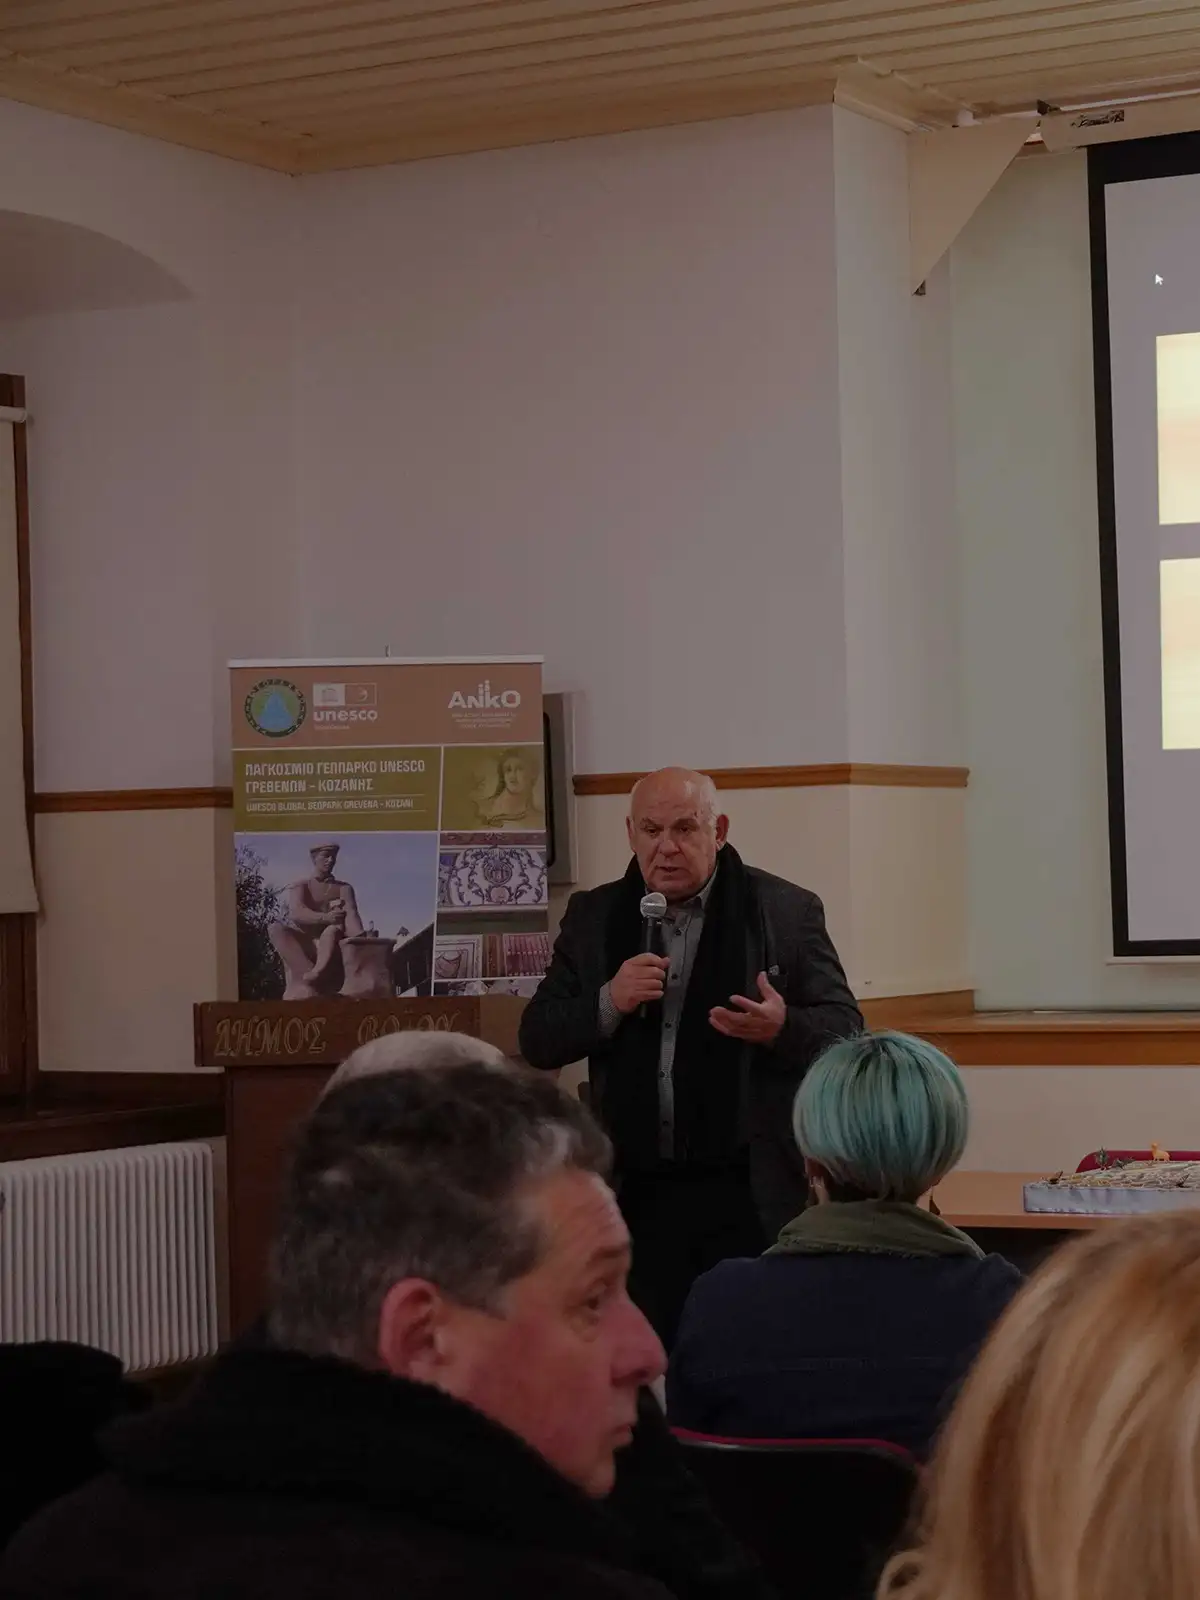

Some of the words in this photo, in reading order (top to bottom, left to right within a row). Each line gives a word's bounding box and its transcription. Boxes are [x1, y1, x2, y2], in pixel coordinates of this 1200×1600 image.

[313, 708, 378, 722] unesco
[245, 762, 314, 776] ΠΑΓΚΟΣΜΙΟ
[379, 759, 426, 774] UNESCO
[245, 779, 307, 794] ΓΡΕΒΕΝΩΝ
[318, 778, 374, 793] ΚΟΖΑΝΗΣ
[214, 1015, 327, 1058] ΔΗΜΟΣ
